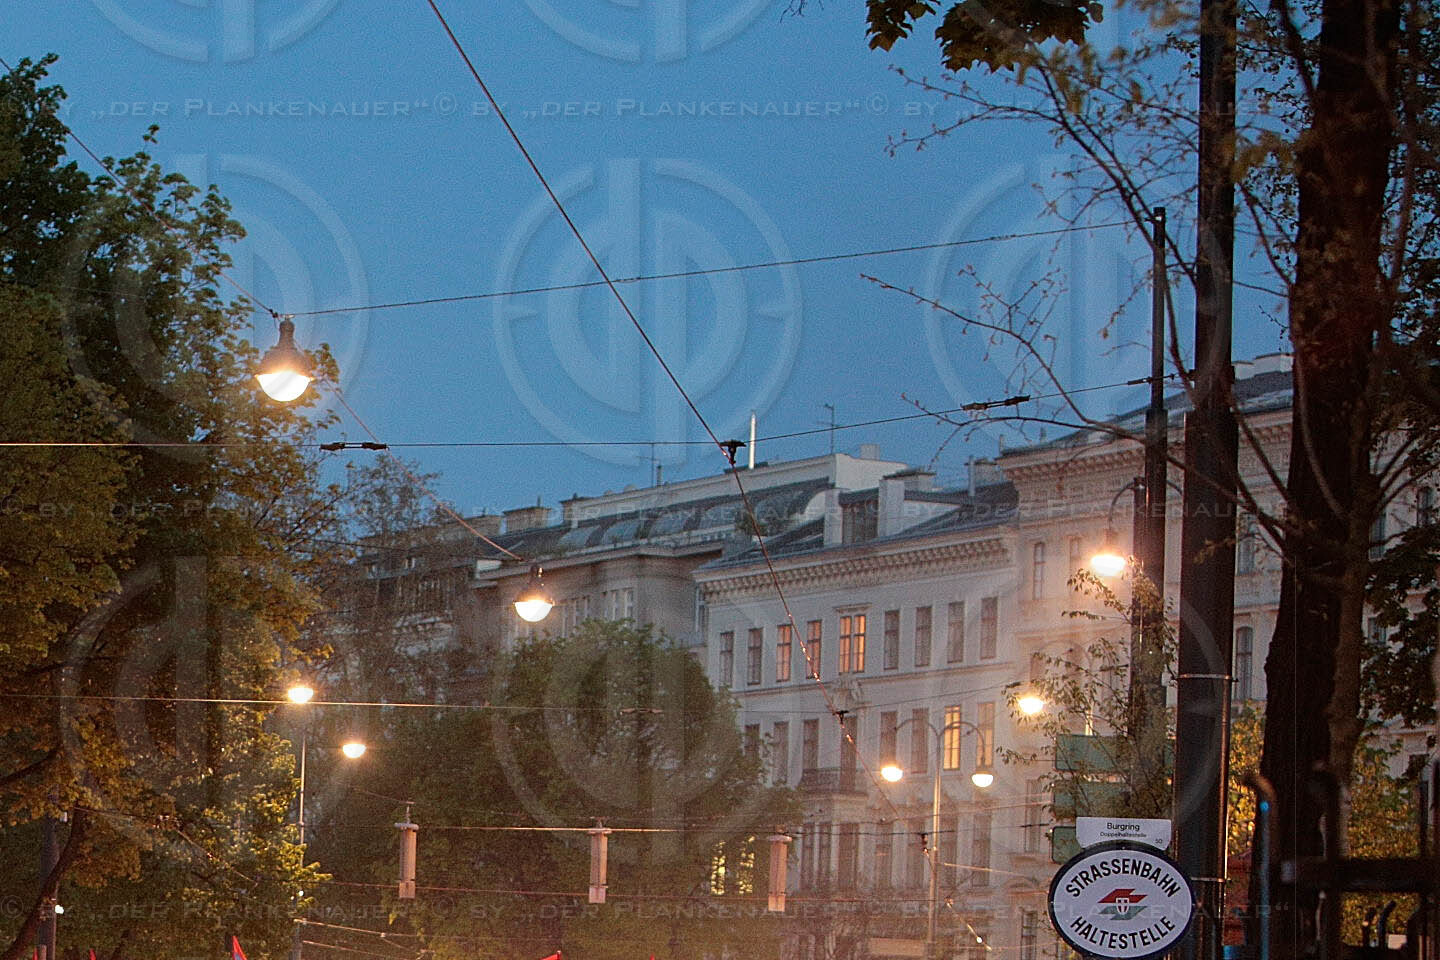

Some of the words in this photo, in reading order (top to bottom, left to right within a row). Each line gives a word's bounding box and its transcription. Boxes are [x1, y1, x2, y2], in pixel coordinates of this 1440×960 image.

[1107, 822, 1140, 831] Burgring
[1066, 858, 1181, 898] STRASSENBAHN
[1070, 915, 1176, 949] HALTESTELLE
